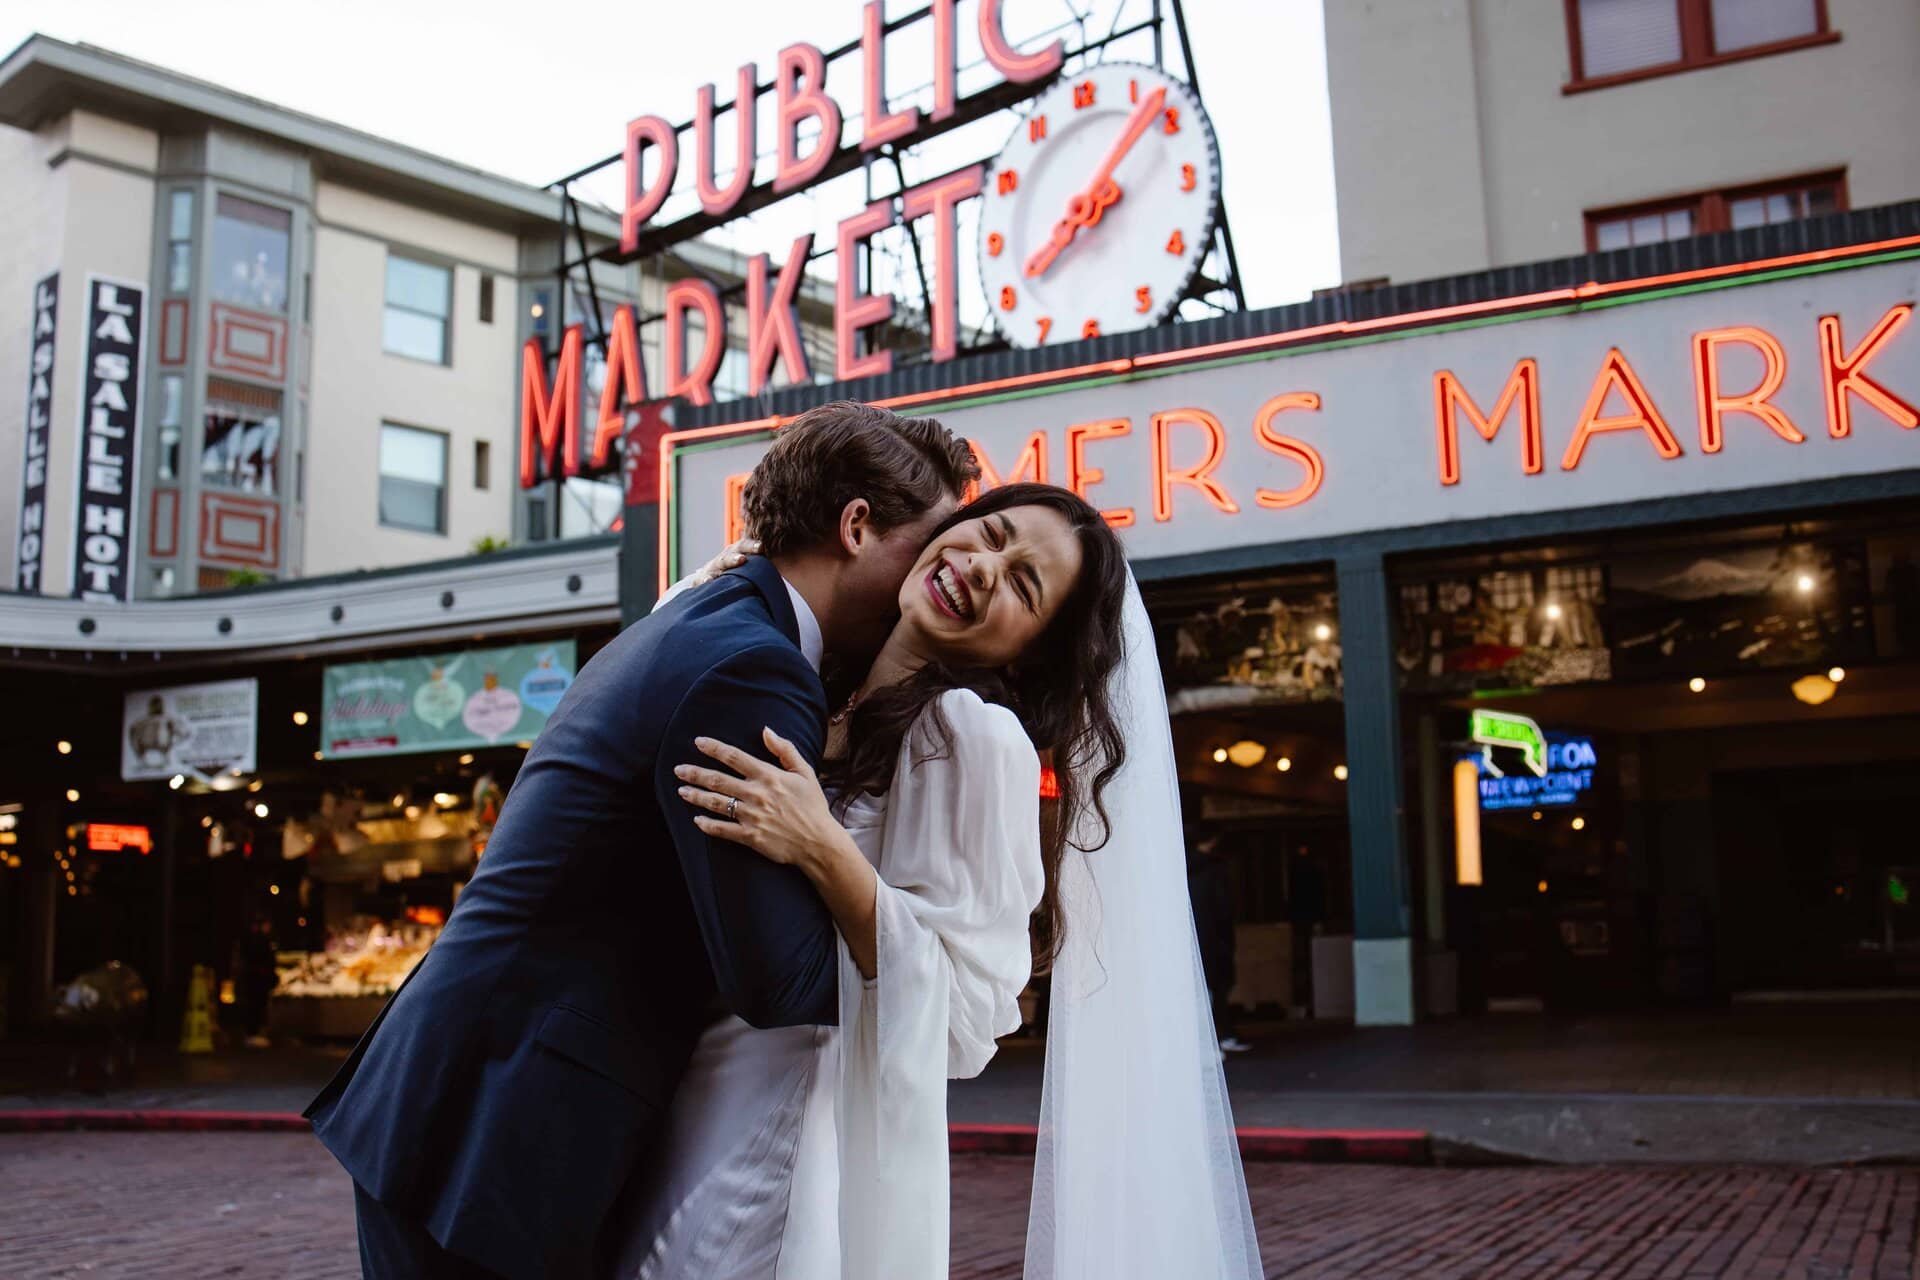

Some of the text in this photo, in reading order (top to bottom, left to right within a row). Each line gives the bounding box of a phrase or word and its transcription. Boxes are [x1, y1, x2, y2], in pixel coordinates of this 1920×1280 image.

[1073, 80, 1096, 110] 12
[1128, 79, 1139, 104] 1
[620, 0, 1065, 254] PUBLIC
[1029, 114, 1047, 143] 11
[1163, 106, 1181, 136] 2
[997, 169, 1018, 196] 10
[1180, 162, 1196, 192] 3
[987, 232, 1004, 257] 9
[1165, 229, 1186, 256] 4
[1000, 285, 1017, 311] 8
[1135, 286, 1152, 314] 5
[520, 164, 985, 489] MARKET
[1036, 317, 1052, 343] 7
[1081, 319, 1101, 340] 6
[1433, 302, 1920, 486] MARK
